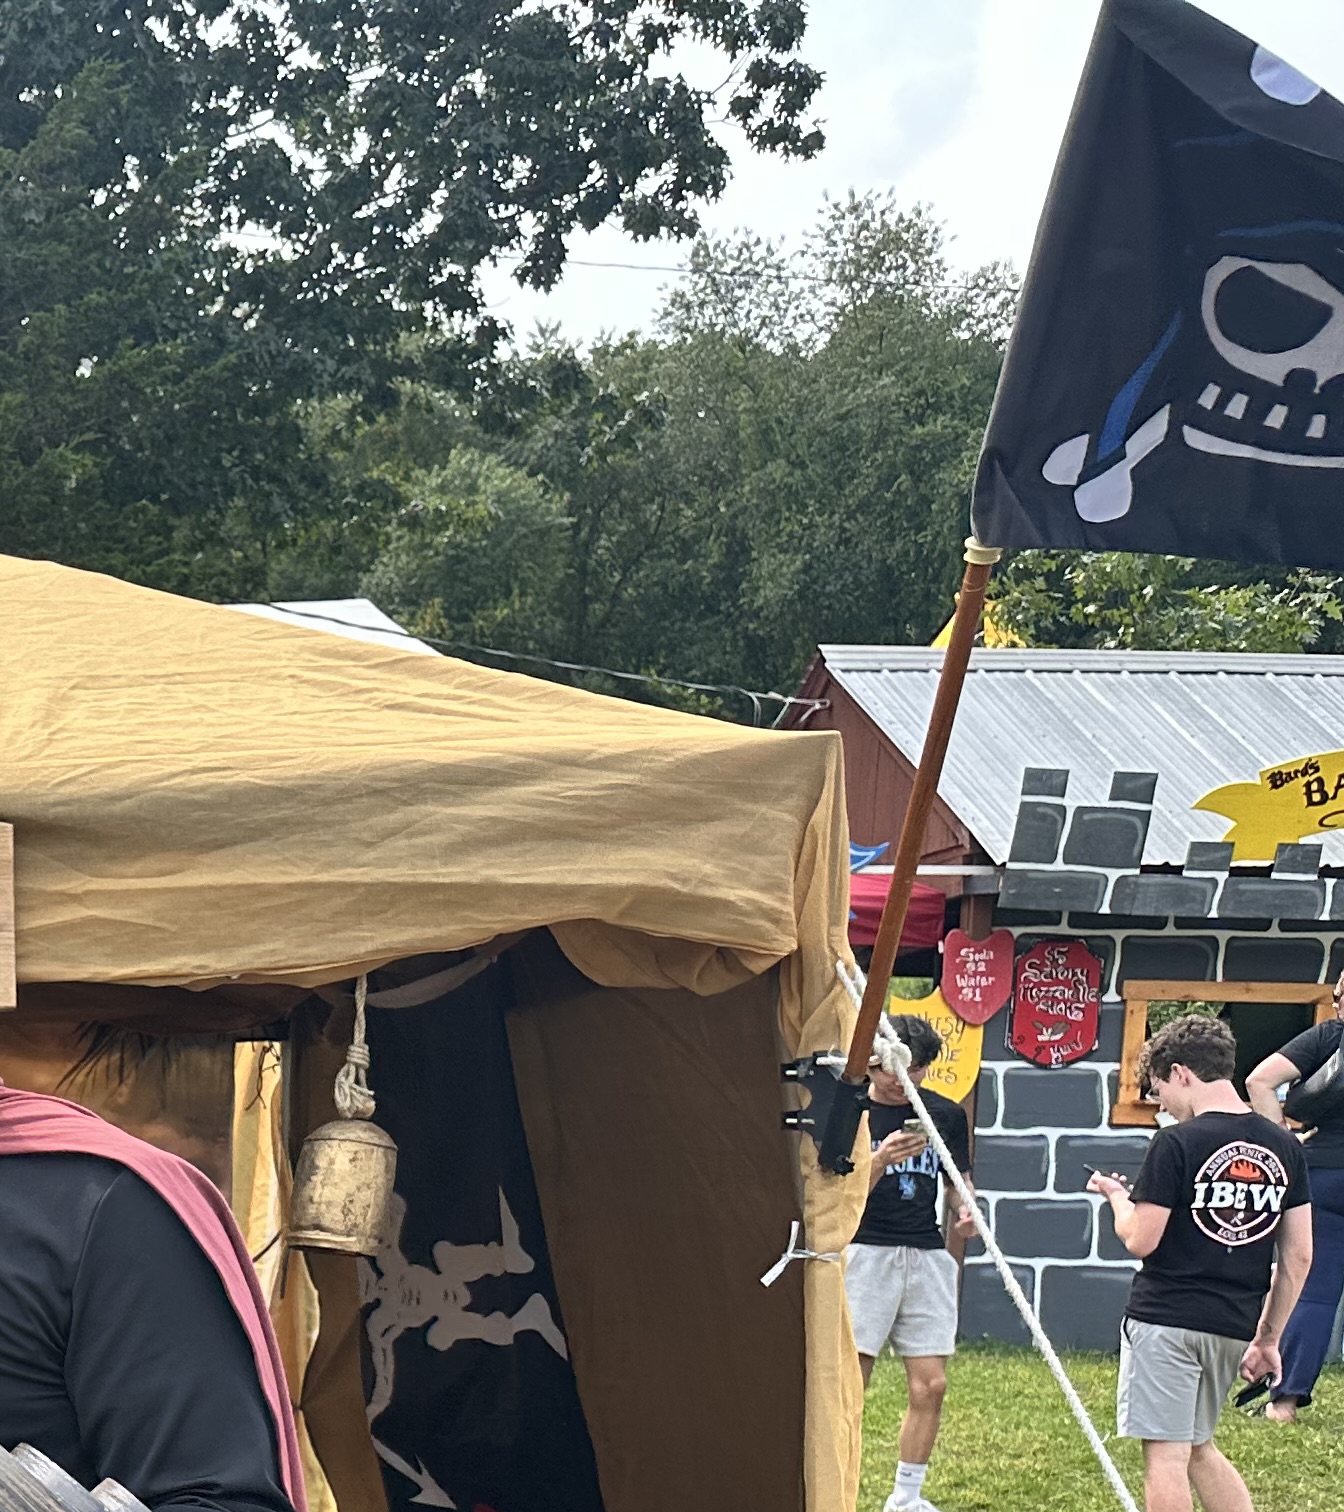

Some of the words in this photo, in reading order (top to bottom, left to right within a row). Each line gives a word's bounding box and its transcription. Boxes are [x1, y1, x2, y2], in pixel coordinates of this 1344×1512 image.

[1266, 757, 1320, 791] Bard's
[955, 947, 994, 963] Soda
[955, 974, 996, 988] Water
[1191, 1181, 1287, 1212] IBEW
